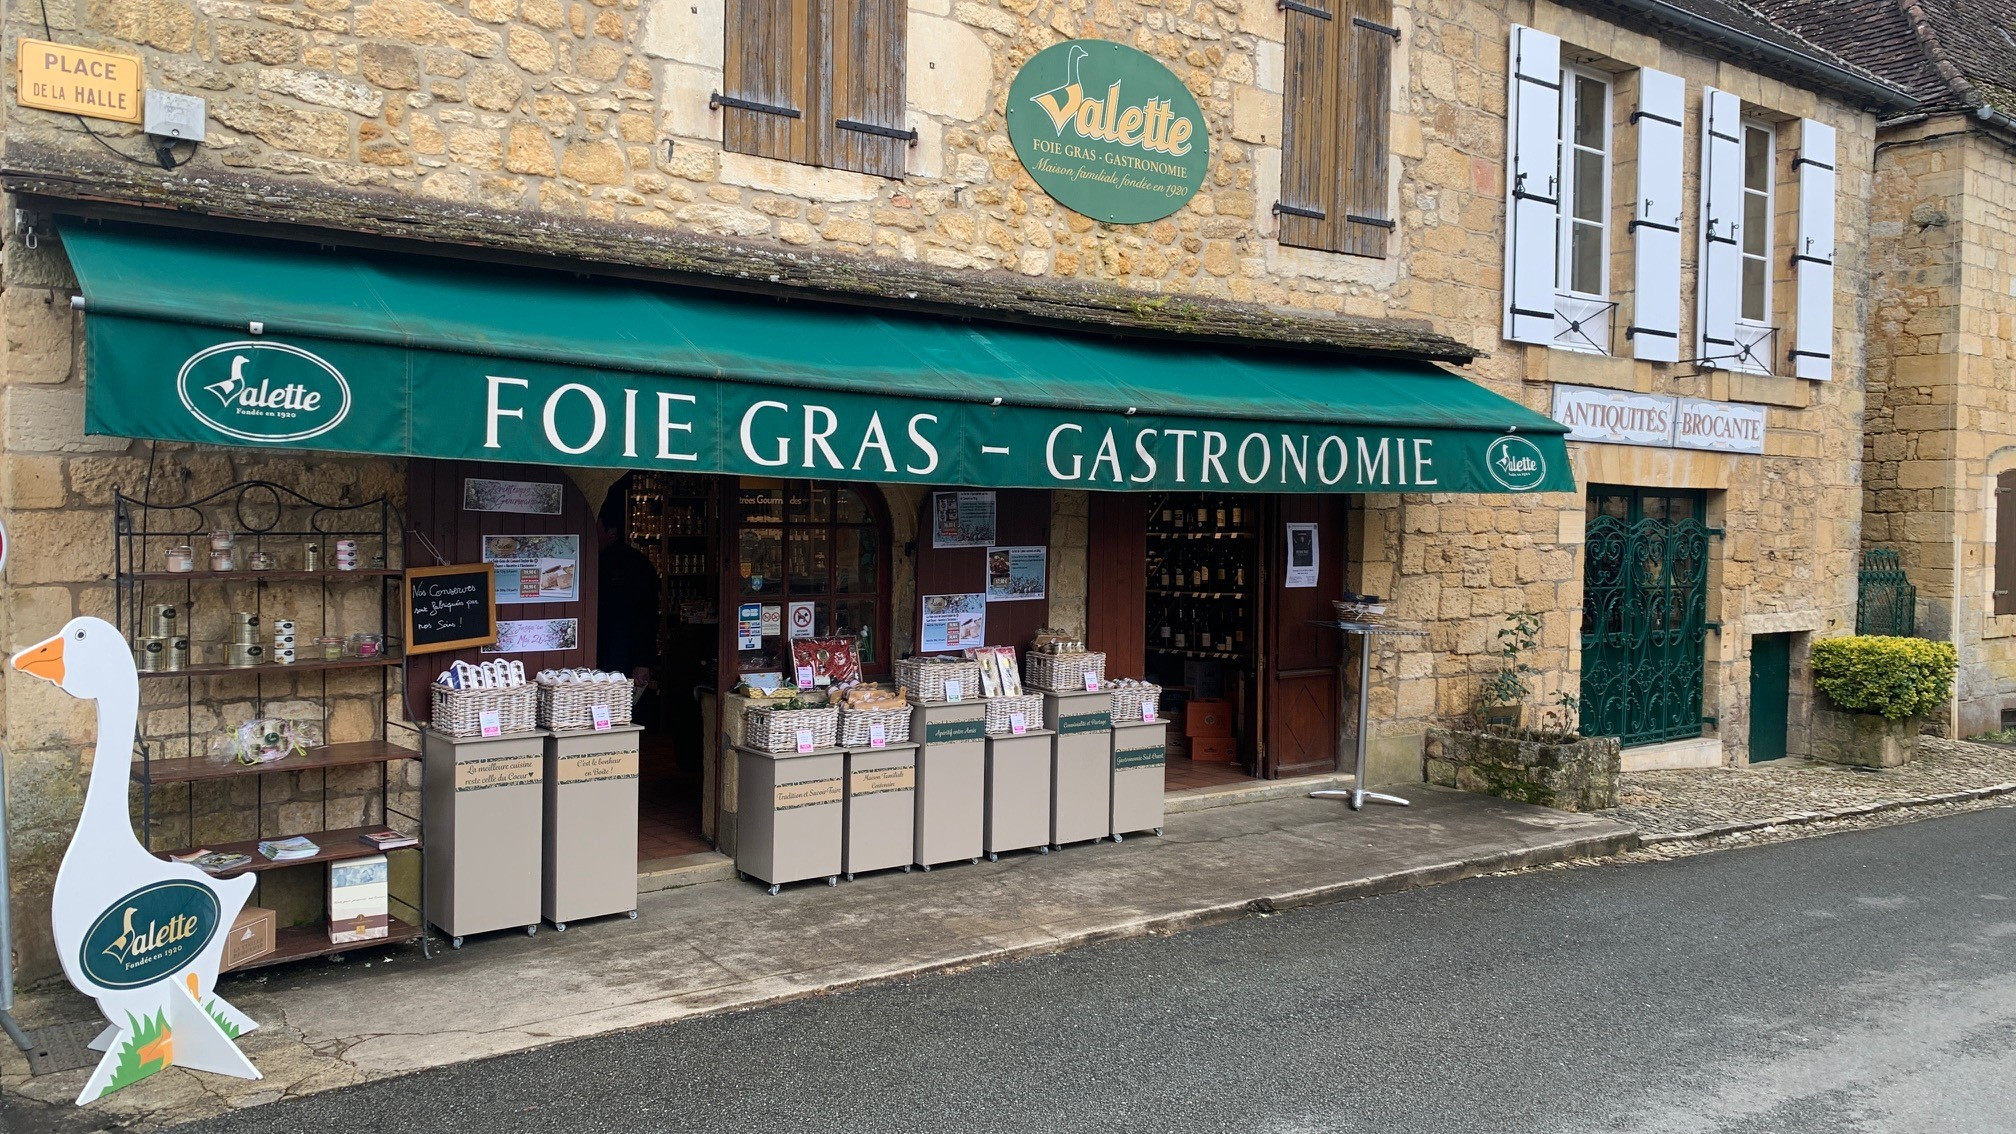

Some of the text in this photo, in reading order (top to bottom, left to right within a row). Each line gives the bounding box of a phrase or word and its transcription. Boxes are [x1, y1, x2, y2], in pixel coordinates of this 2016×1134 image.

[44, 52, 117, 81] PLACE
[33, 82, 127, 110] DE LA HALLE
[1030, 74, 1192, 156] Valette
[1033, 138, 1062, 155] FOIE
[1064, 144, 1096, 161] GRAS
[1104, 152, 1188, 178] GASTRONOMIE
[1032, 158, 1188, 198] Maison familiale fondée en 1920
[204, 362, 321, 411] Valette
[236, 407, 264, 417] Fondée
[277, 411, 296, 419] 1920
[1562, 402, 1761, 441] ANTIQUITÉS BROCANTE
[483, 375, 698, 462] FOIE
[740, 400, 939, 475] GRAS
[1045, 423, 1438, 486] GASTRONOMIE
[413, 580, 476, 598] Nos Conserves
[466, 600, 479, 609] par
[467, 765, 477, 775] La
[478, 763, 509, 772] meilleure
[598, 757, 622, 766] bonheur
[465, 777, 481, 785] reste
[482, 774, 497, 783] celle
[498, 773, 507, 781] du
[777, 792, 803, 801] Tradition
[102, 907, 198, 964] Valette
[125, 945, 183, 971] Fondée en 1920
